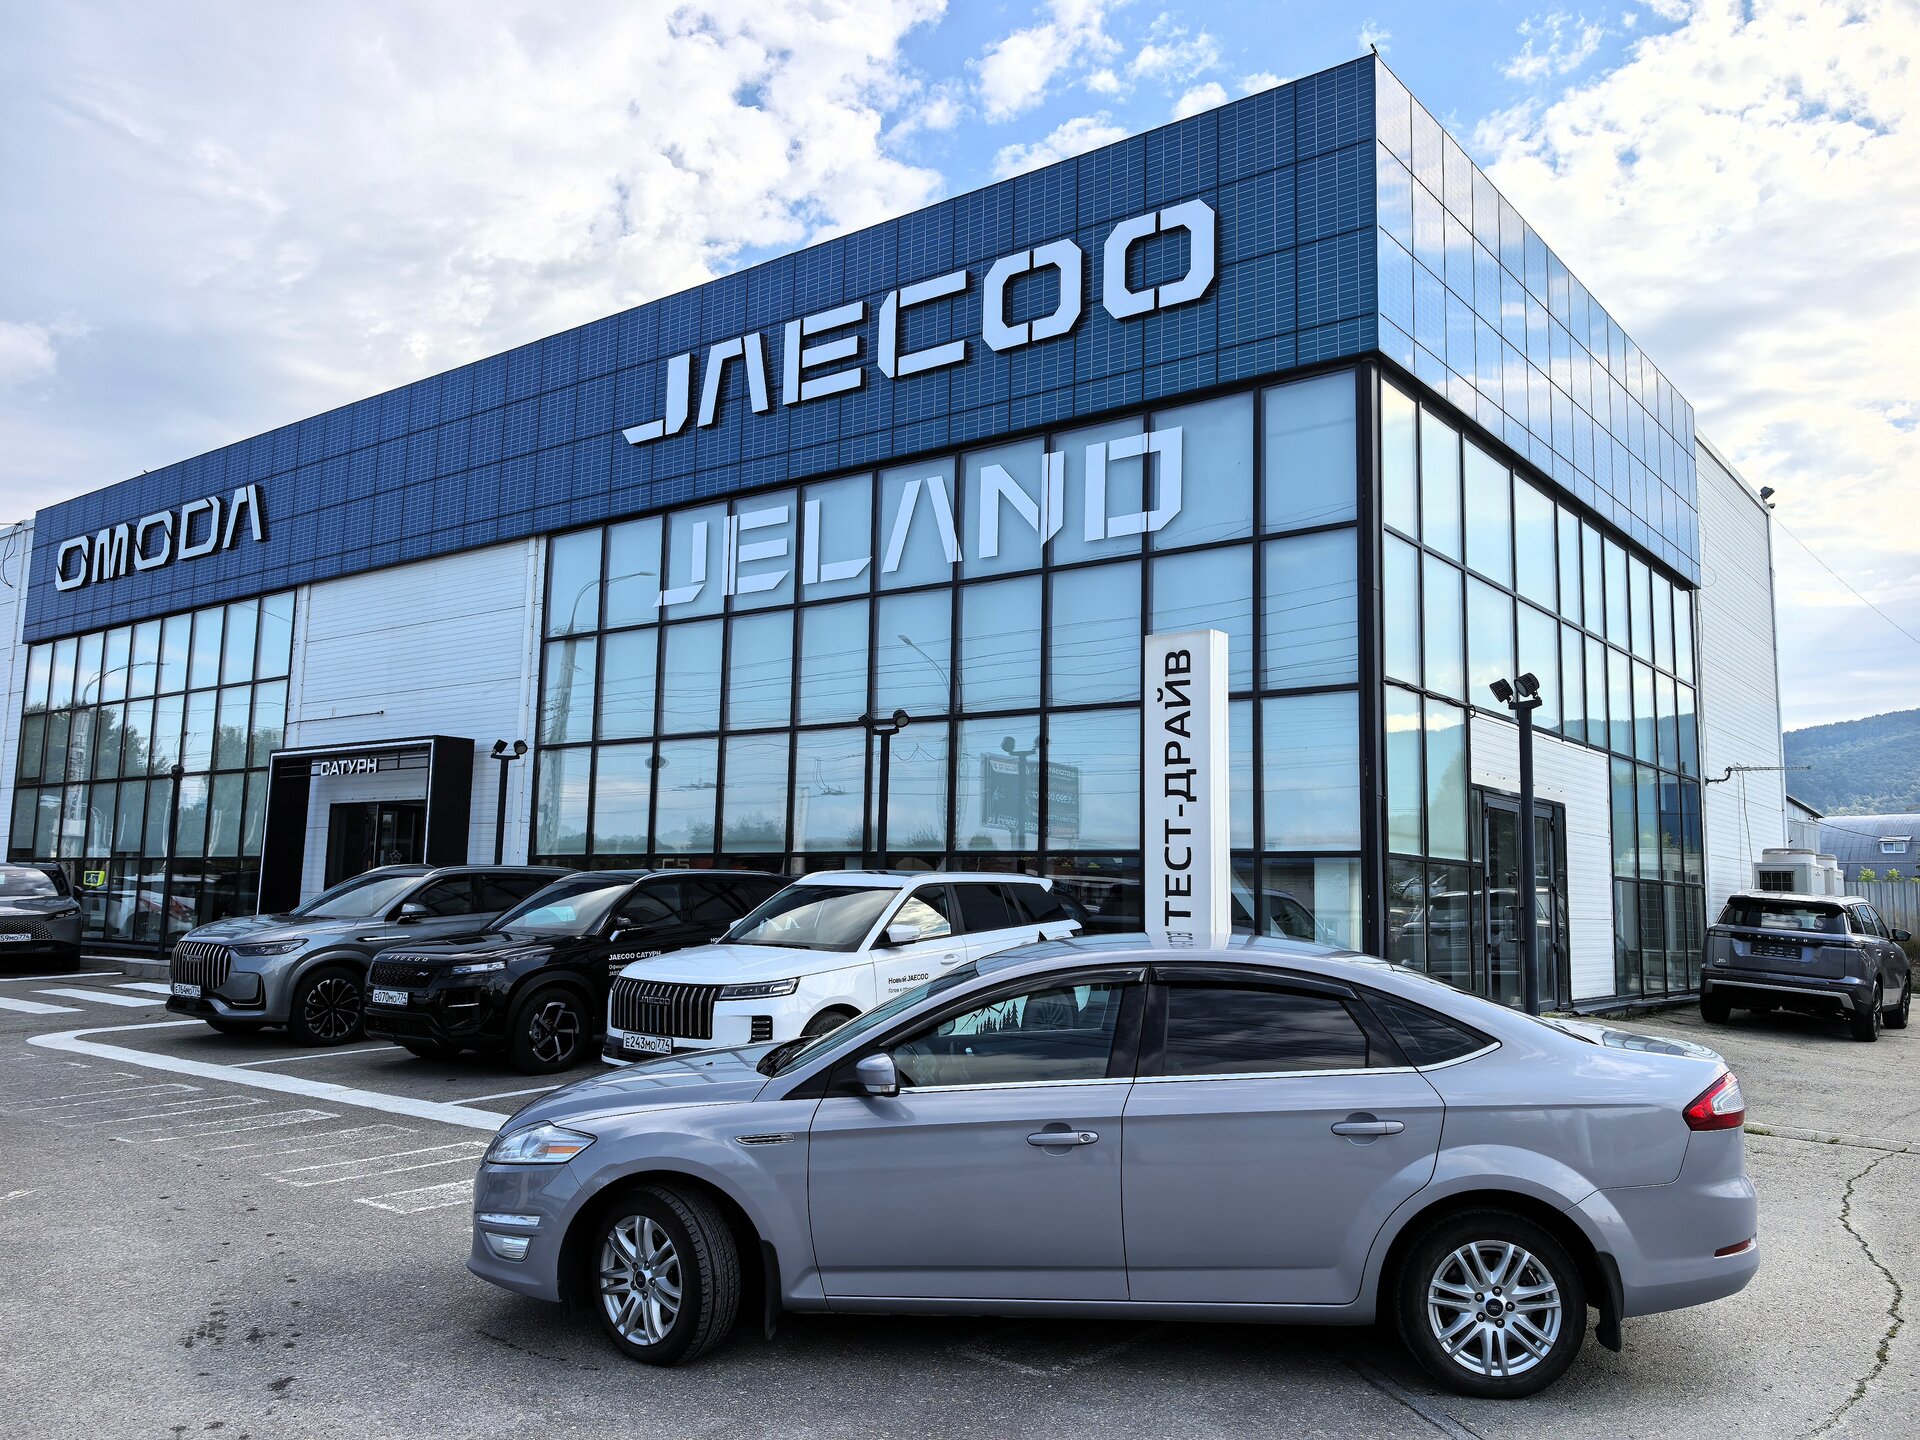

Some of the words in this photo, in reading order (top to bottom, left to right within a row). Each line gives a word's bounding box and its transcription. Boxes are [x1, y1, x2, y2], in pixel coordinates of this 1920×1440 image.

[621, 199, 1216, 446] JAECOO
[54, 484, 262, 592] OMODA
[652, 426, 1184, 608] JELAND
[320, 758, 378, 776] САТУРН
[1156, 649, 1197, 927] ТЕСТ-ДРАЙВ
[908, 973, 928, 982] JAECOO
